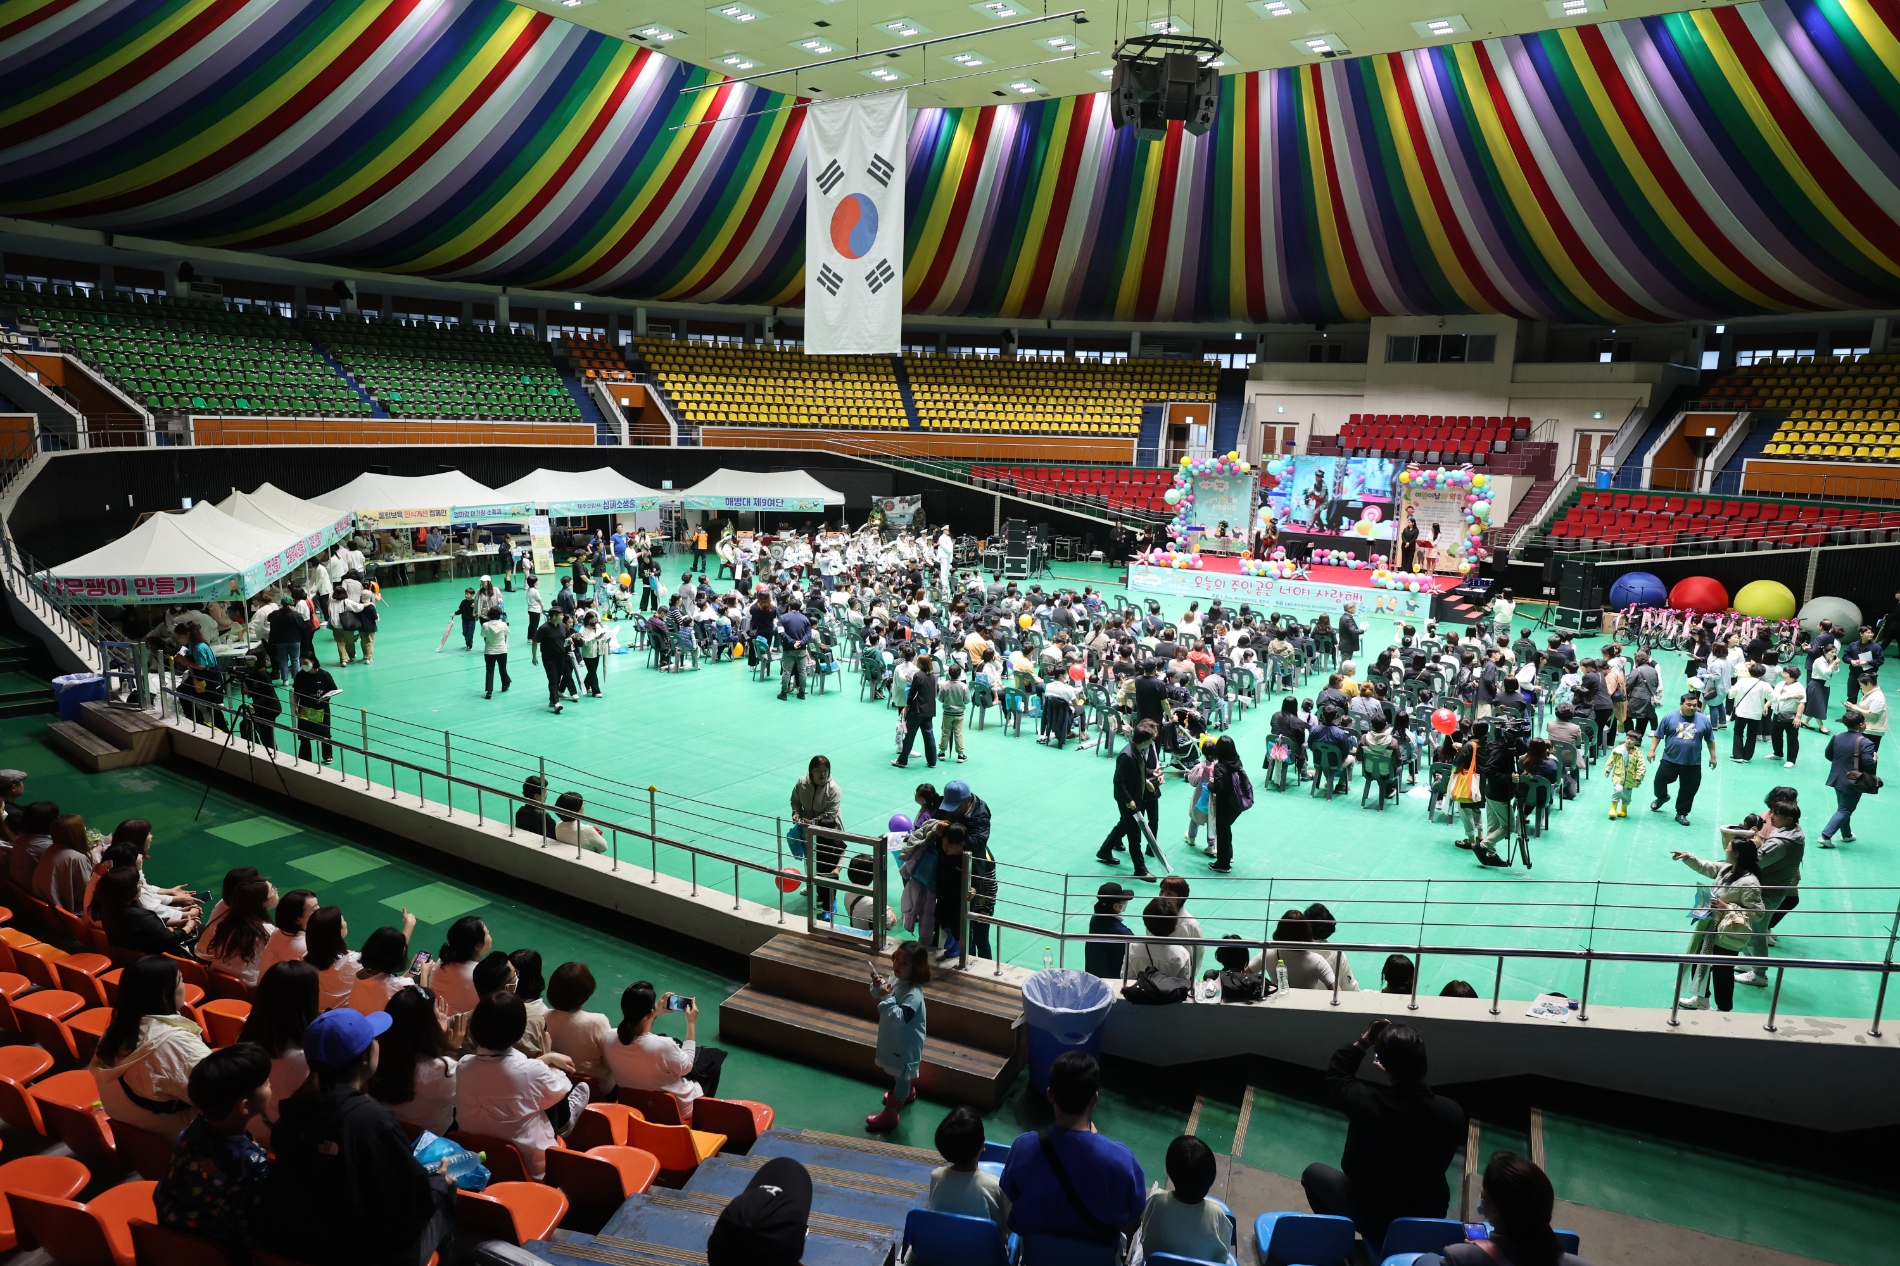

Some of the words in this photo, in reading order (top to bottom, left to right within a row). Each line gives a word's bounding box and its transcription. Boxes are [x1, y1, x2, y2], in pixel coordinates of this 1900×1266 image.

[603, 499, 636, 510] 심폐소생술
[725, 497, 751, 507] 해병대
[753, 498, 784, 508] 제9여단
[404, 510, 429, 518] 인식개선
[429, 509, 447, 517] 캠페인
[453, 511, 470, 519] 엄마랑
[470, 509, 486, 518] 아기랑
[133, 576, 196, 596] 만들기
[1194, 575, 1226, 591] 오늘의
[1231, 579, 1274, 597] 주인공은
[1279, 585, 1311, 600] 너야!
[1315, 588, 1363, 604] 사랑해!
